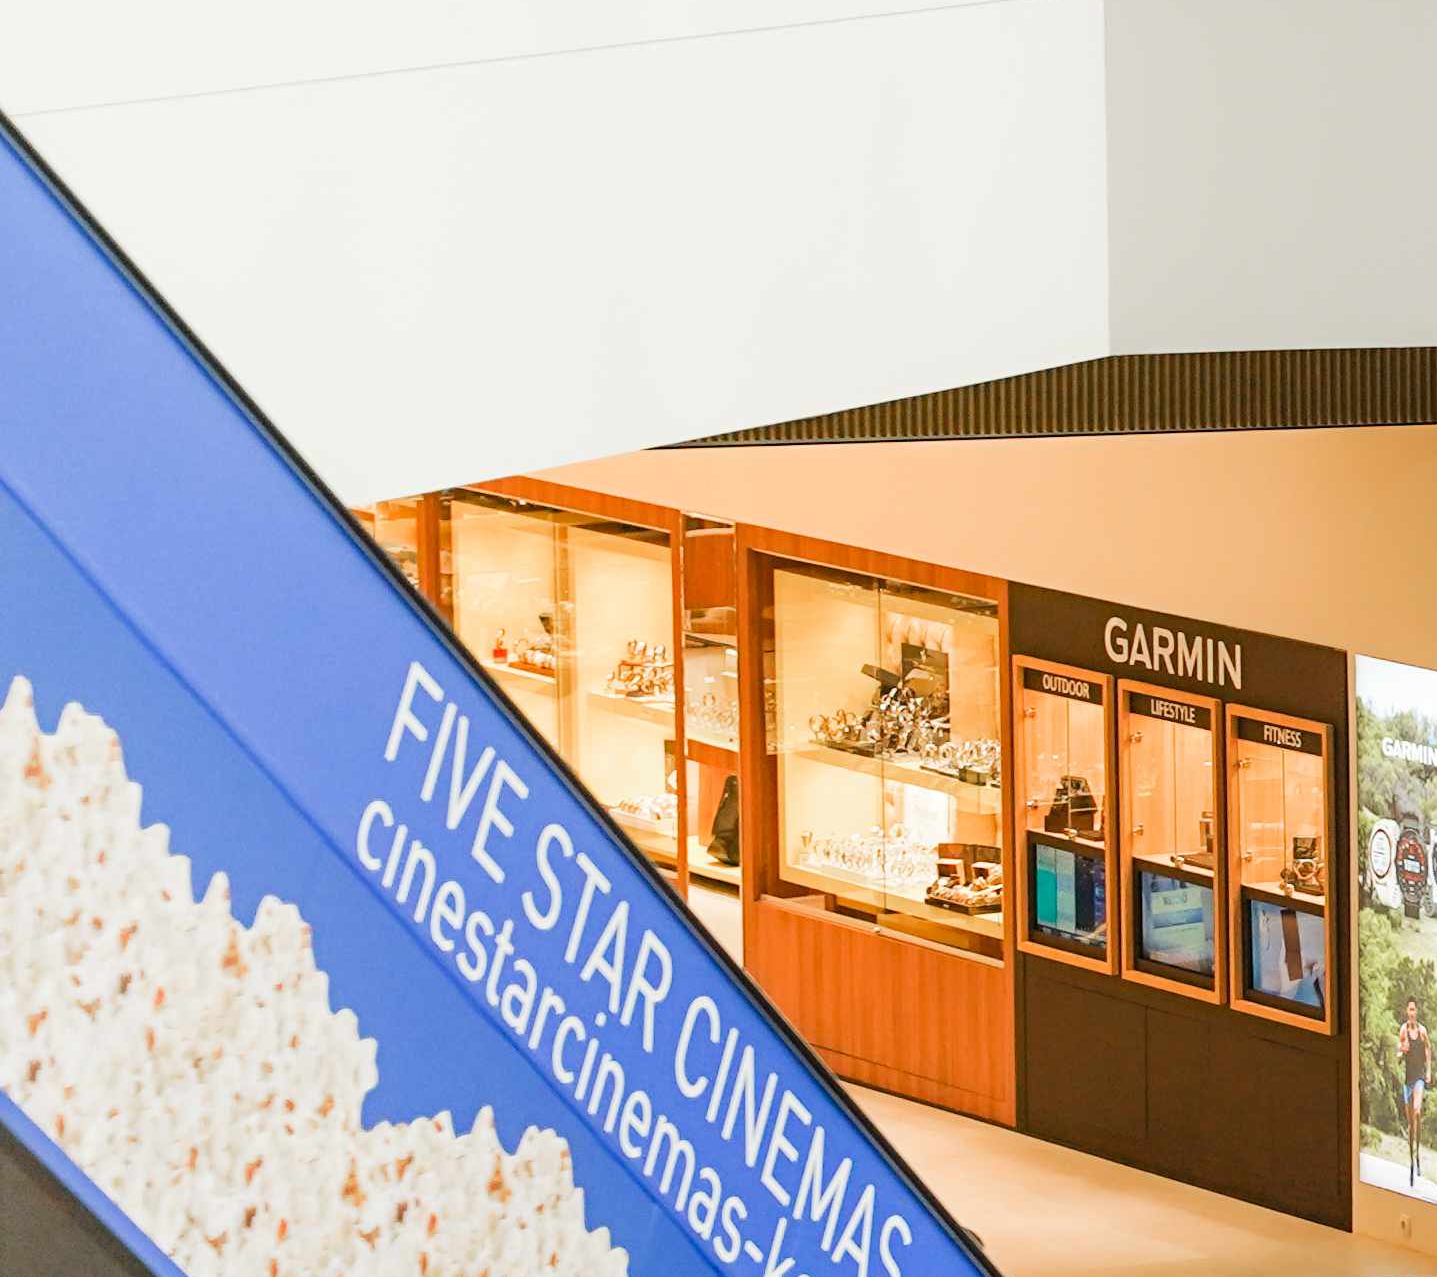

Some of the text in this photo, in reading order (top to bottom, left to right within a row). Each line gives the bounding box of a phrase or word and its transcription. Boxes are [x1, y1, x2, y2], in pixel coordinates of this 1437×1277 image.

[1105, 616, 1242, 690] GARMIN
[1042, 673, 1090, 699] OUTDOOR
[1150, 698, 1196, 723] LIFESTYLE
[1263, 724, 1303, 748] FITNESS
[384, 660, 529, 883] FIVE
[521, 823, 672, 1052] STAR
